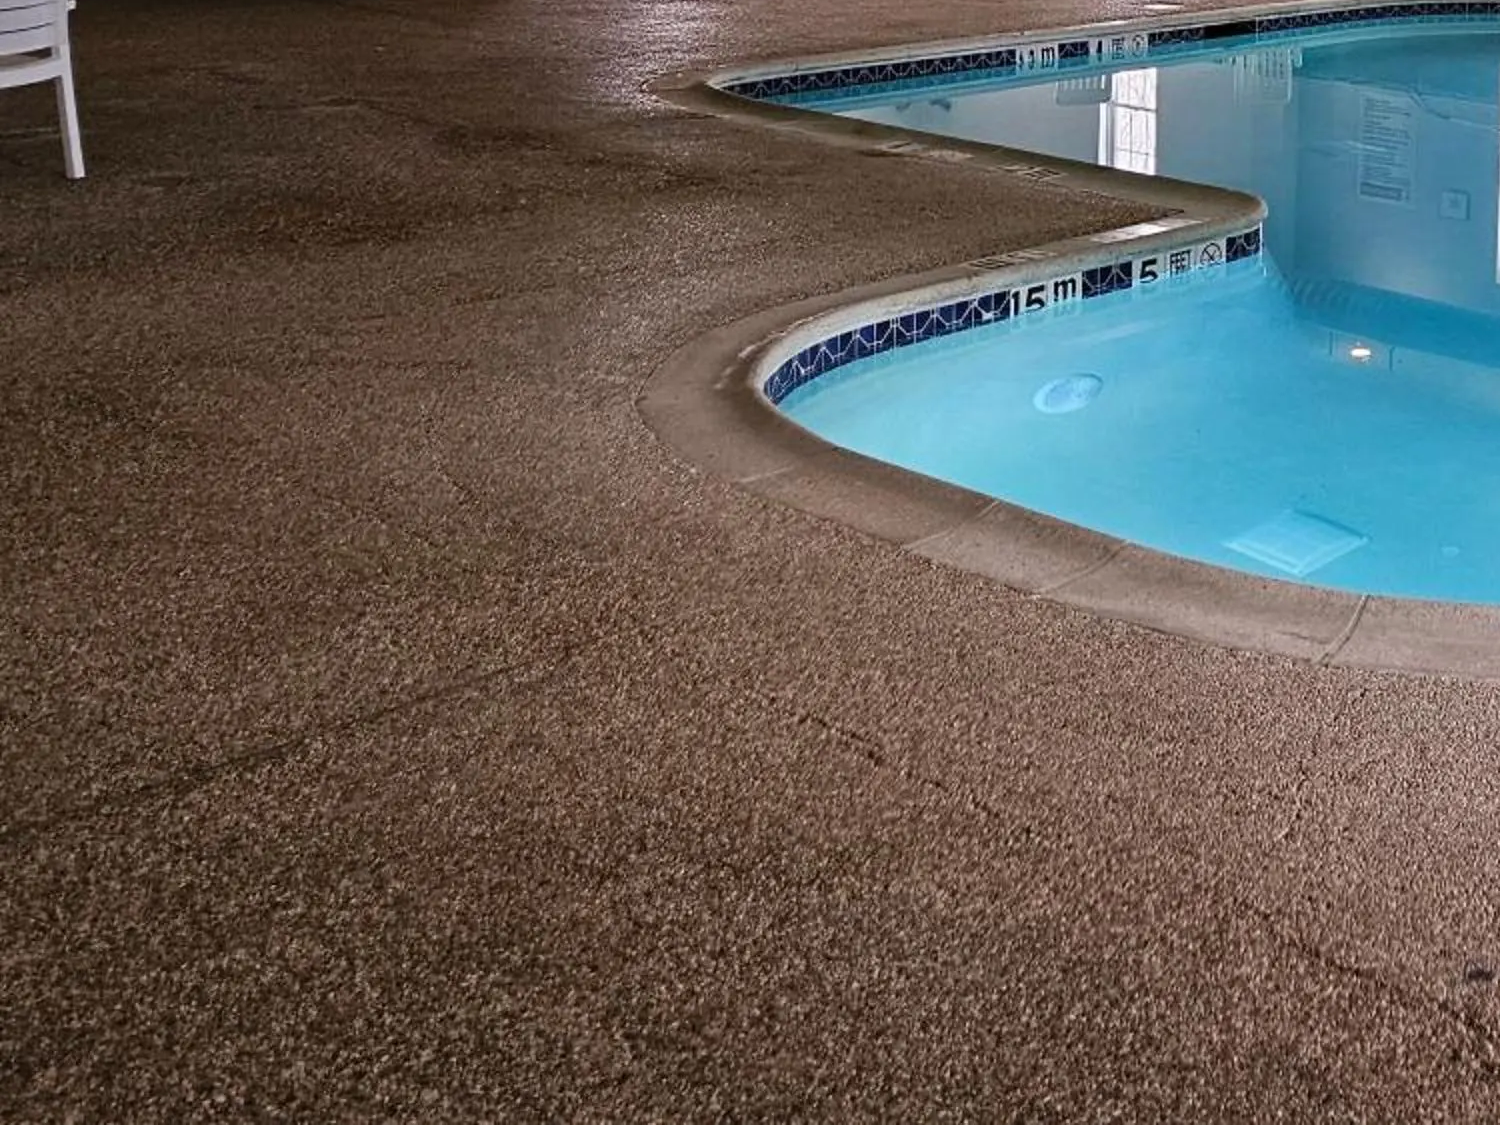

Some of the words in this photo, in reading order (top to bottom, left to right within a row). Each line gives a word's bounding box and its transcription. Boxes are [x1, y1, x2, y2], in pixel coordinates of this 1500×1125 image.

[1139, 258, 1158, 284] 5
[1169, 250, 1192, 276] FEET
[1053, 277, 1077, 302] m
